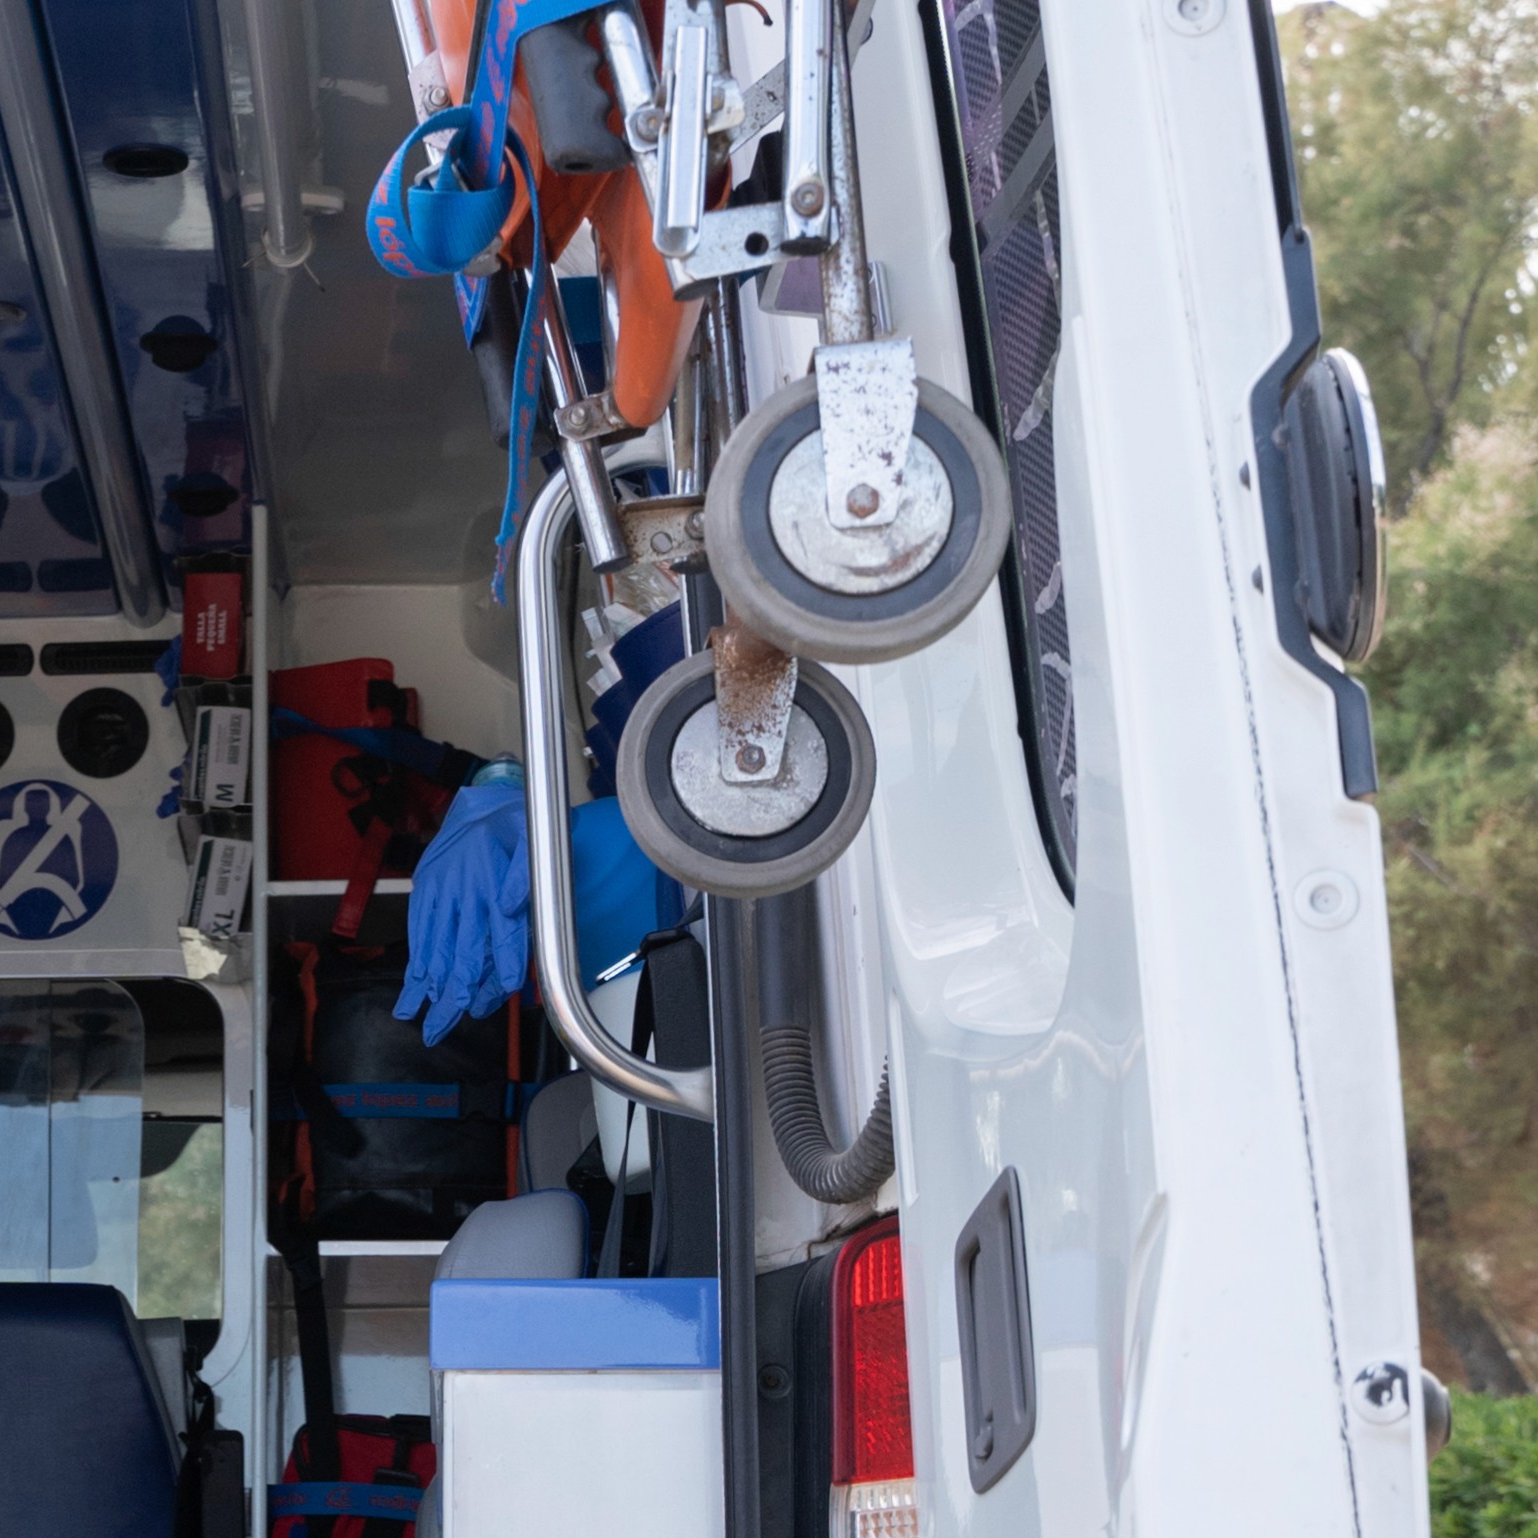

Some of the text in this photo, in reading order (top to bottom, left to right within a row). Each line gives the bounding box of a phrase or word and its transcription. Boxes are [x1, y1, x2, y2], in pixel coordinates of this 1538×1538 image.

[196, 611, 206, 644] TALLA
[215, 784, 235, 802] M
[212, 909, 235, 936] XL
